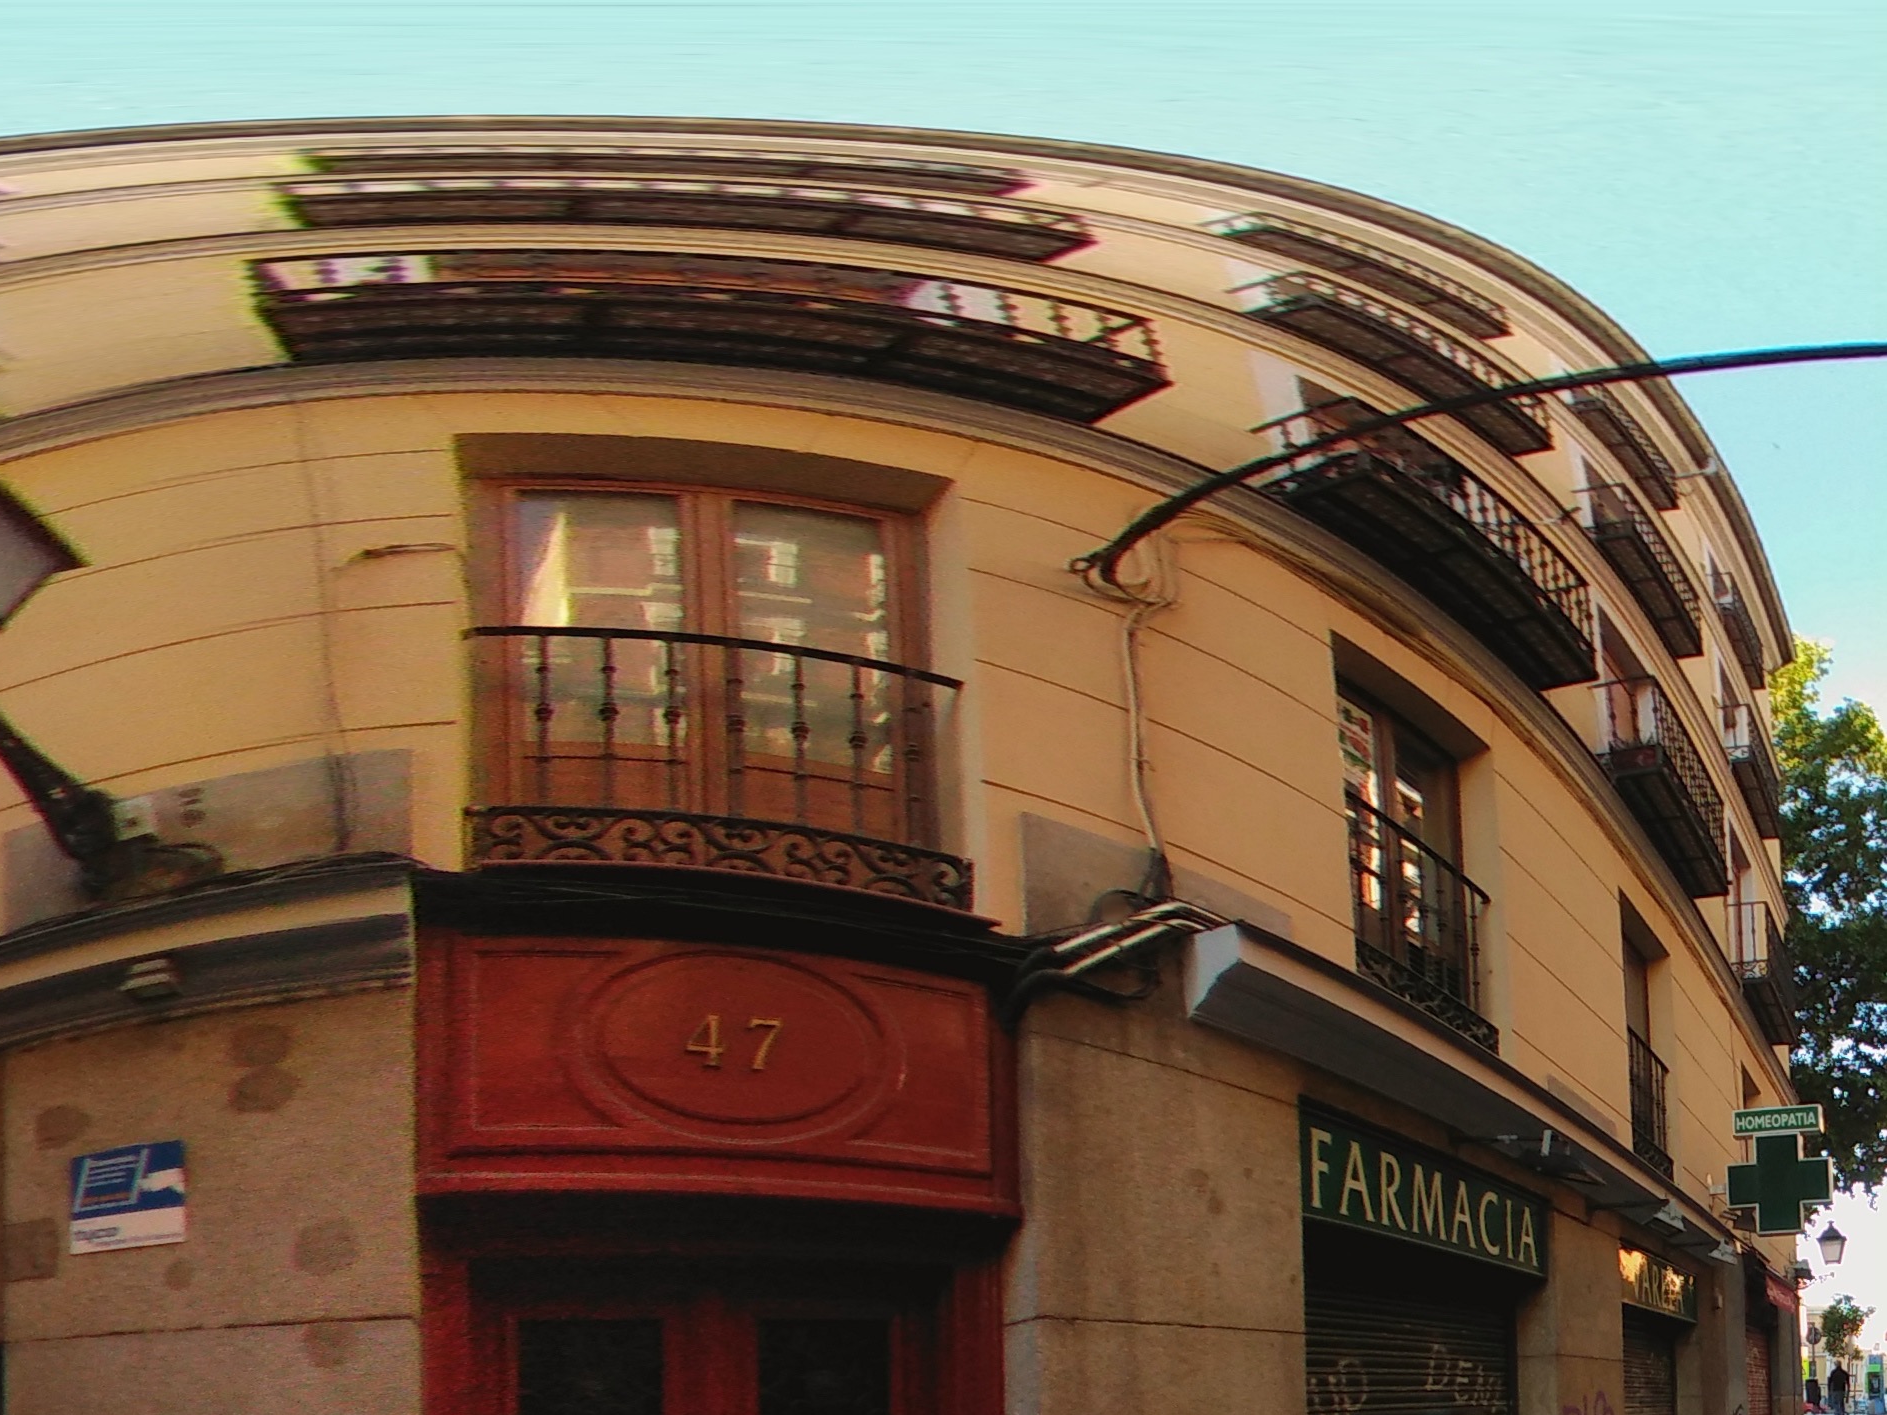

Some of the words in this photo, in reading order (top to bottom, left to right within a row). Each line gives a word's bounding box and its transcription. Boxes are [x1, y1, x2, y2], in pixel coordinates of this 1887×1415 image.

[685, 1013, 783, 1070] 47
[1736, 1112, 1816, 1131] HOMEOPATIA
[1309, 1127, 1539, 1268] FARMACIA
